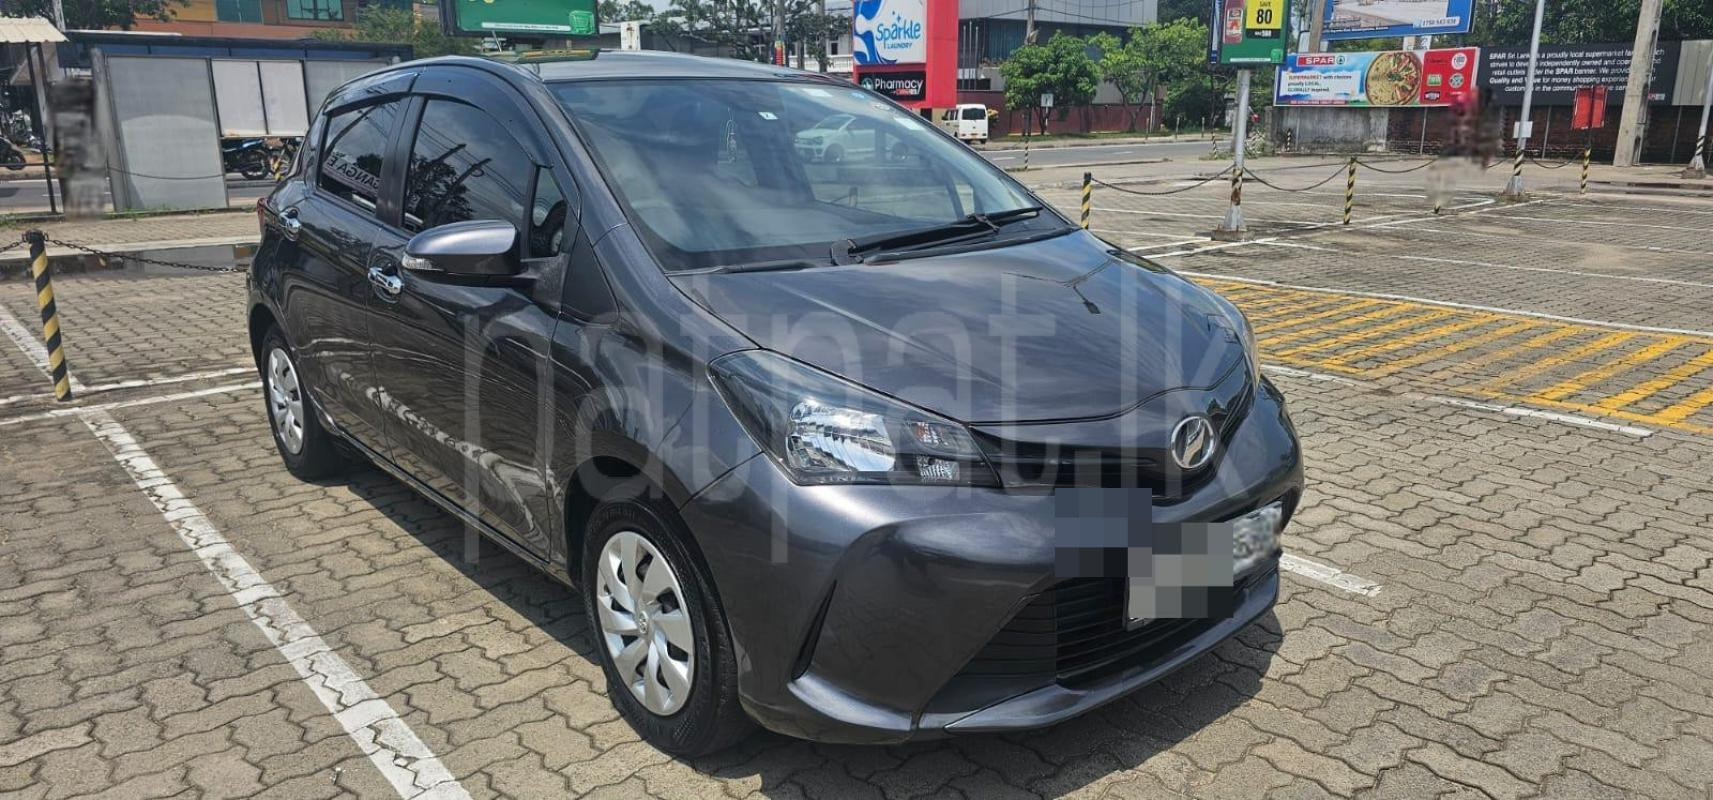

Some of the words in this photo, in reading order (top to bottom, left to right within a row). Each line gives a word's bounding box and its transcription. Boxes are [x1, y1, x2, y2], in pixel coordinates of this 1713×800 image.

[1256, 9, 1272, 25] 80
[876, 19, 921, 49] Sparkle
[1490, 52, 1506, 60] SPAR
[1517, 51, 1531, 59] Lank
[1546, 51, 1569, 60] proudly
[1570, 50, 1584, 58] local
[1585, 49, 1624, 59] supermarket
[1306, 57, 1334, 65] SPAR
[1539, 59, 1580, 68] independently
[1603, 58, 1615, 66] and
[1555, 67, 1573, 75] SPAR
[1490, 77, 1510, 85] Quality
[1551, 77, 1571, 85] money
[1572, 76, 1600, 85] shopping
[875, 78, 924, 94] Pharmacy
